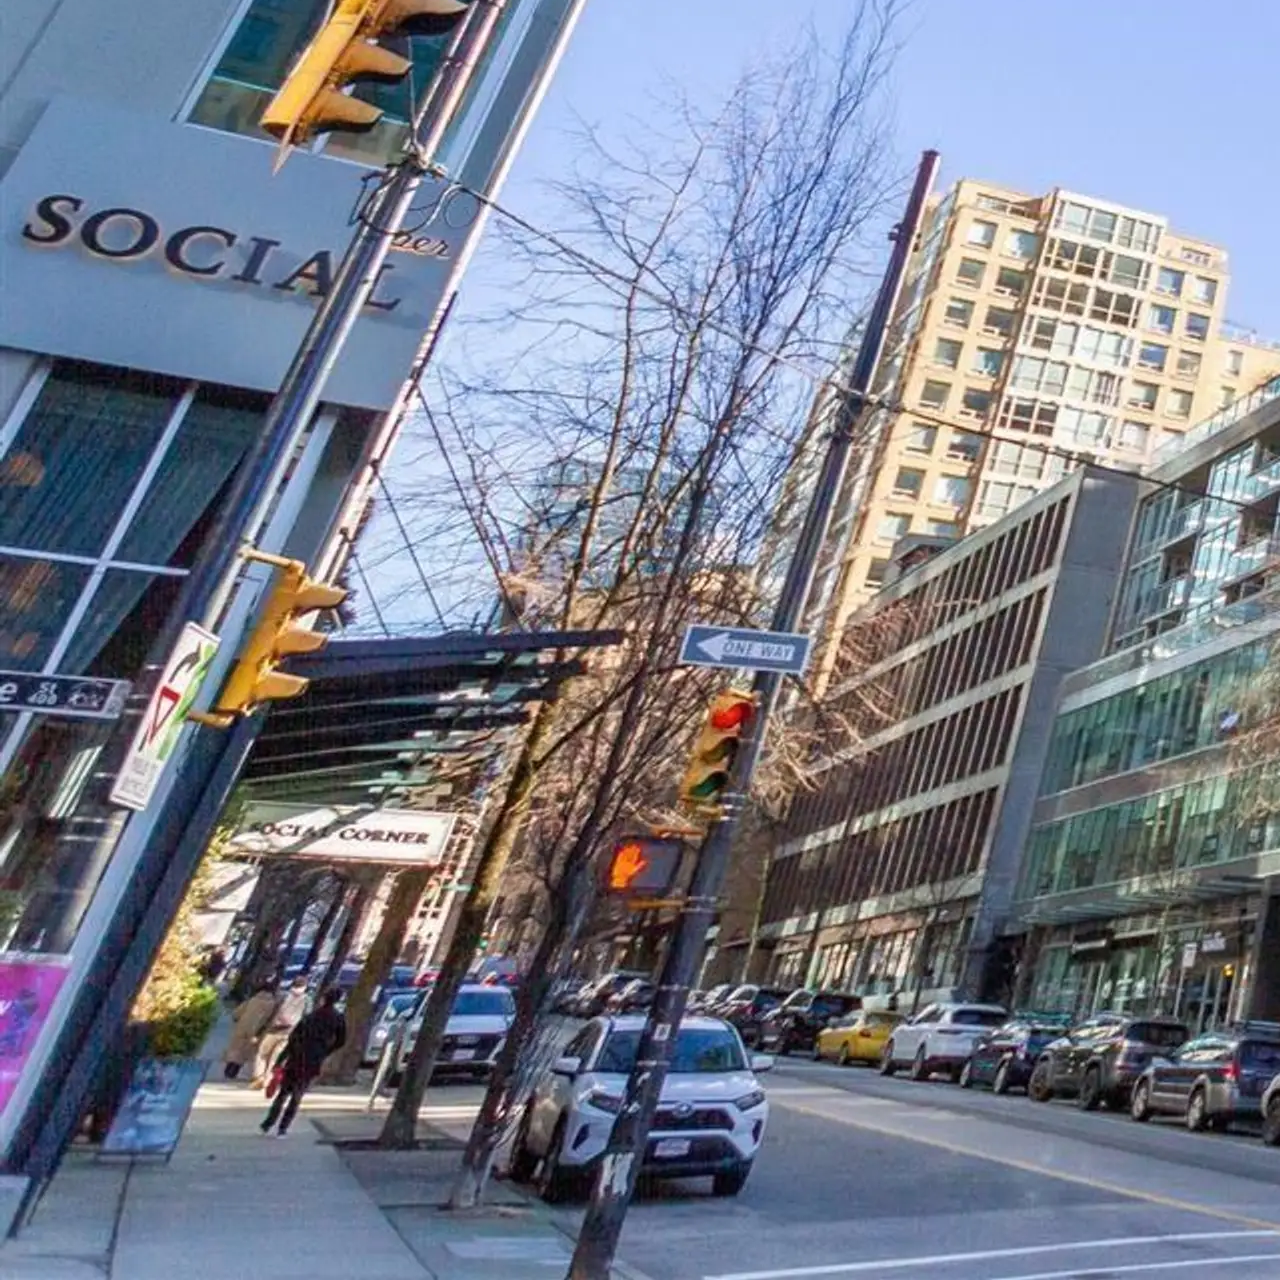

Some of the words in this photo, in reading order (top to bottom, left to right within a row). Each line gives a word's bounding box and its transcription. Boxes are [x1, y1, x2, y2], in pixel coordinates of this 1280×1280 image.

[22, 194, 401, 311] SOCIAL
[722, 640, 753, 656] ONE
[760, 643, 793, 659] WAY
[339, 828, 430, 844] CORNER
